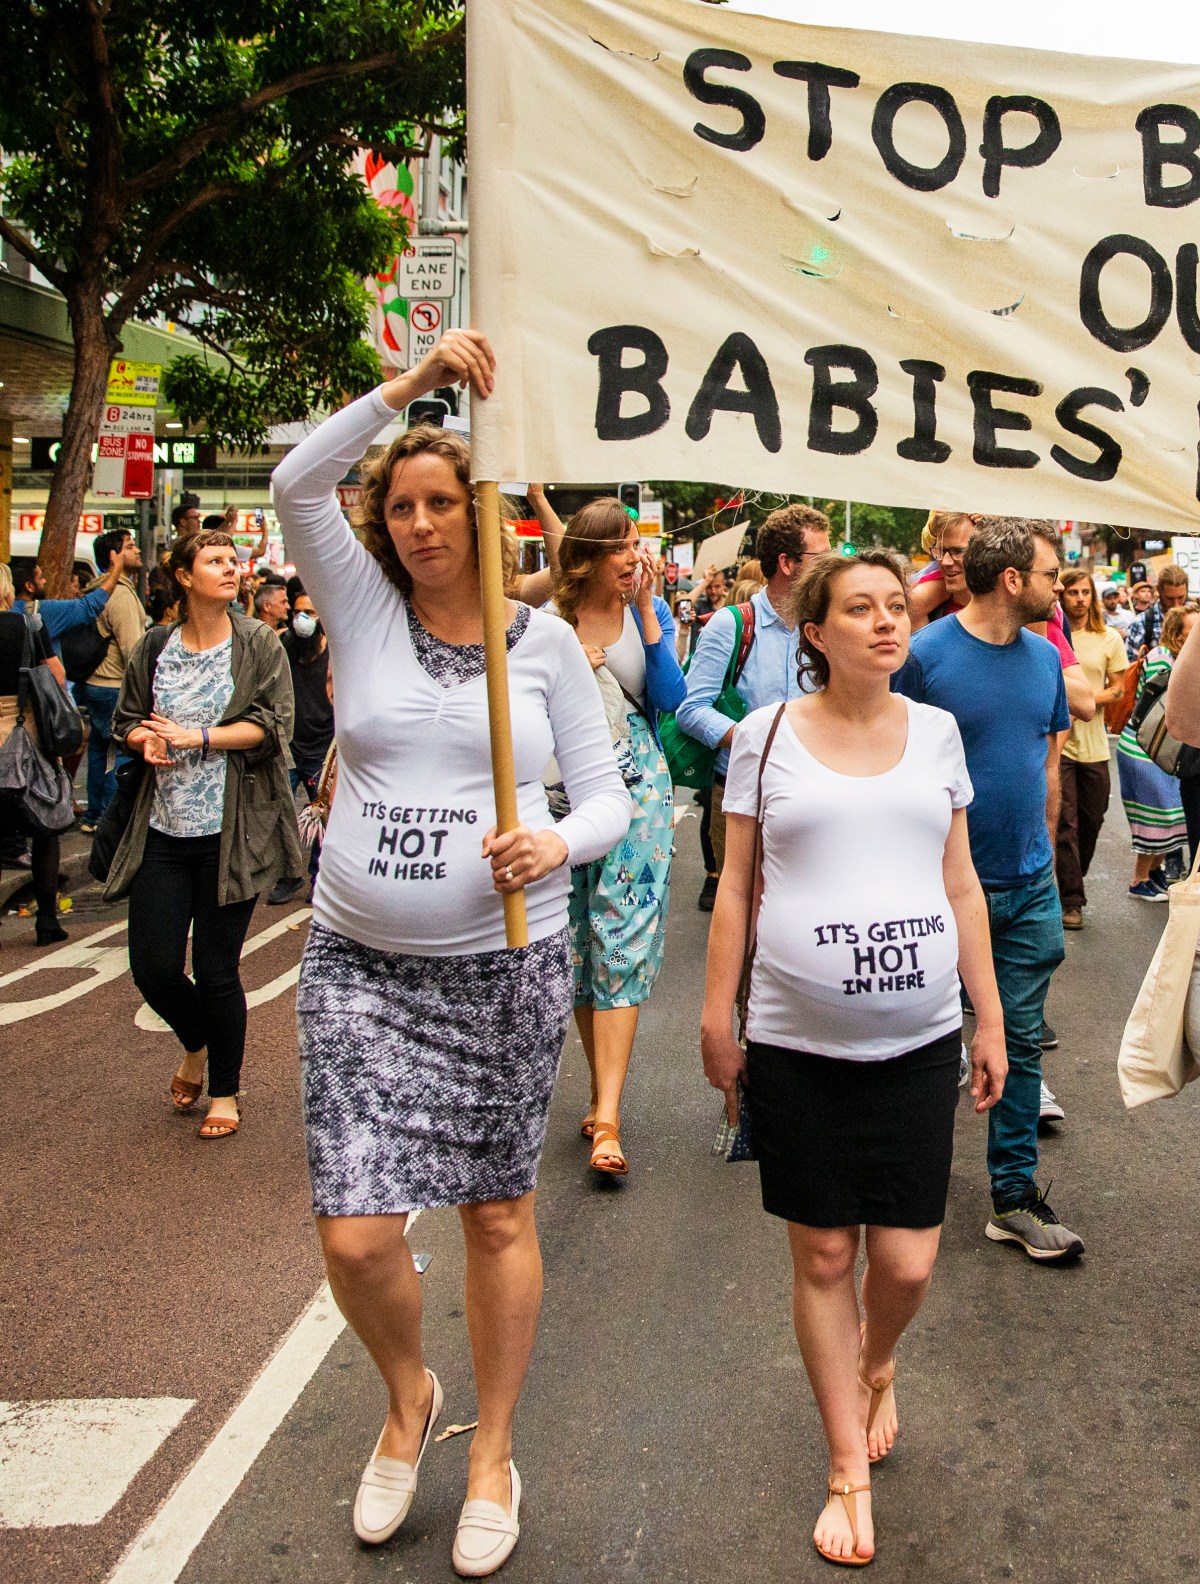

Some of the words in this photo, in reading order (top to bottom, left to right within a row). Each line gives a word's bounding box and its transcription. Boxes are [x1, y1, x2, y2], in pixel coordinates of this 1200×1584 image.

[683, 48, 1062, 198] STOP
[406, 263, 448, 275] LANE
[411, 279, 442, 291] END
[417, 334, 435, 345] NO
[414, 347, 431, 355] LEF
[586, 324, 1151, 482] BABIES'
[108, 407, 119, 421] B
[122, 411, 152, 421] 24hrs
[102, 437, 122, 447] BUS
[135, 438, 148, 450] NO
[173, 442, 195, 455] OPEN
[99, 446, 124, 457] ZONE
[127, 451, 153, 461] STOPPING
[362, 801, 387, 820] IT'S
[389, 806, 478, 824] GETTING
[377, 825, 449, 858] HOT
[368, 857, 388, 877] IN
[394, 861, 447, 880] HERE
[814, 922, 859, 946] IT'S
[867, 915, 945, 943] GETTING
[853, 942, 919, 976] HOT
[842, 977, 872, 995] IN
[878, 970, 926, 992] HERE
